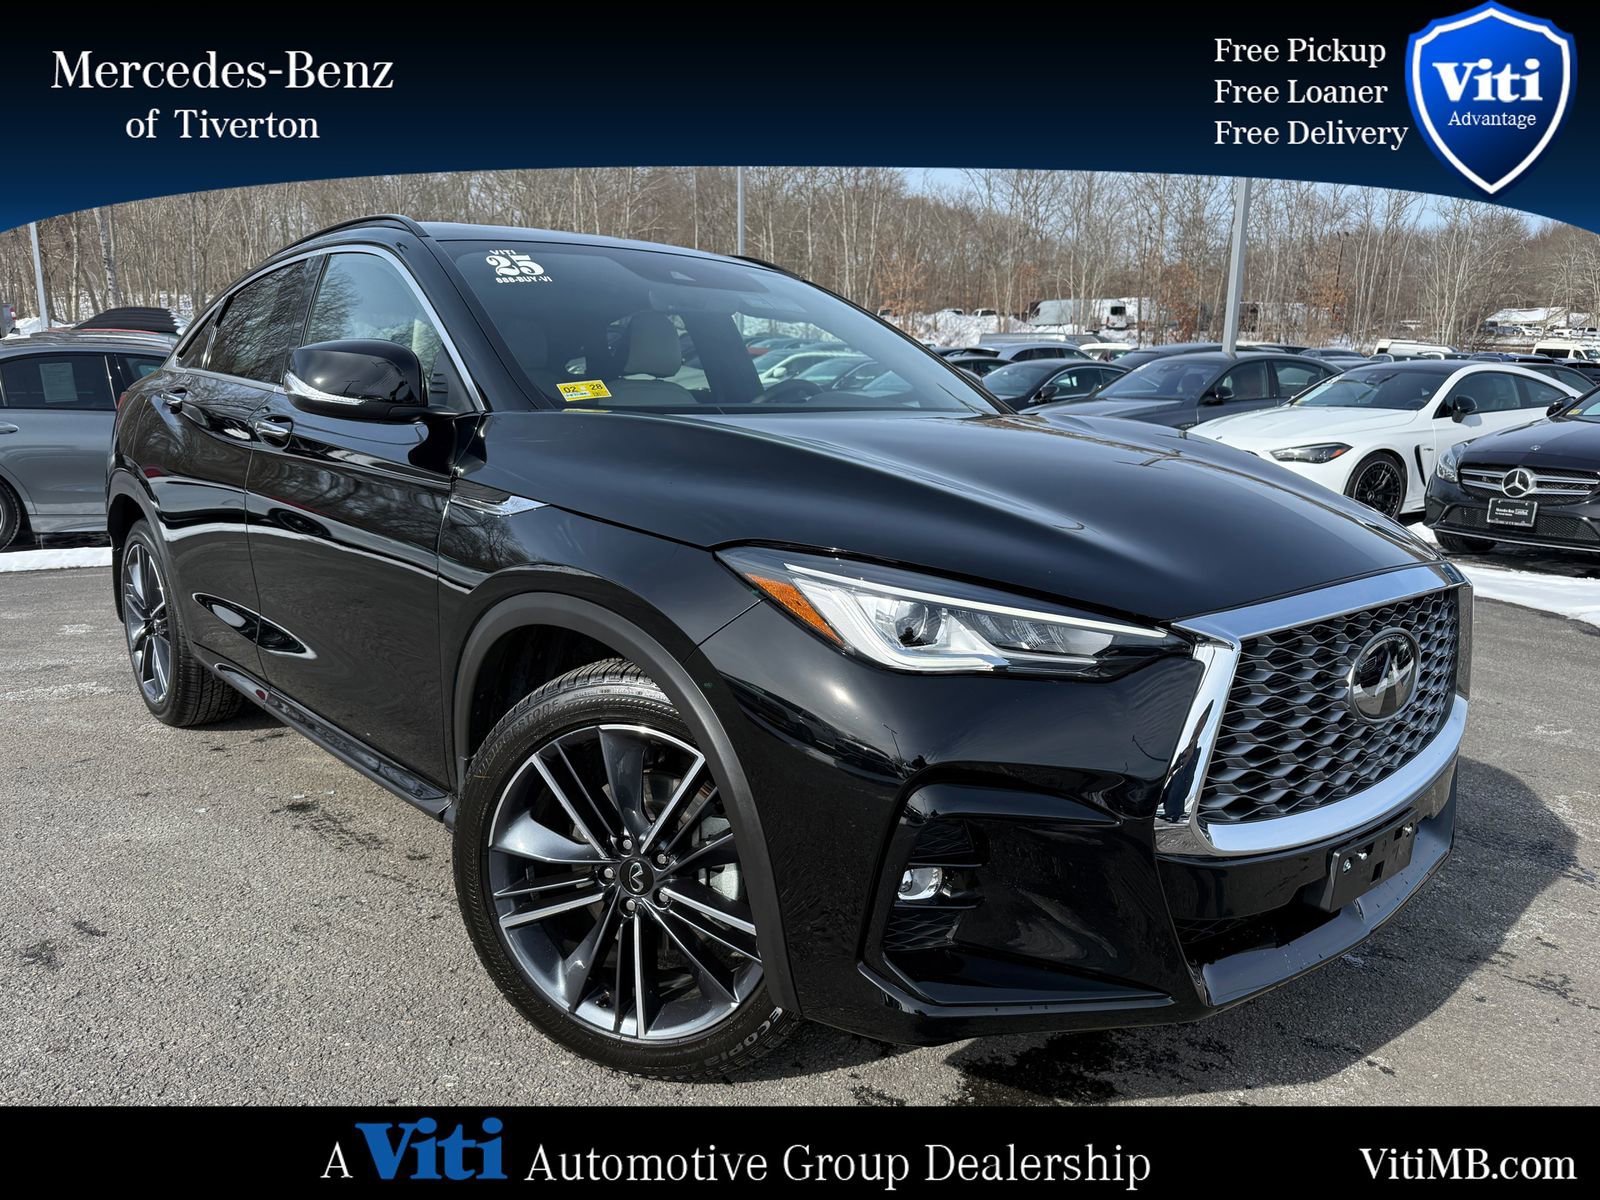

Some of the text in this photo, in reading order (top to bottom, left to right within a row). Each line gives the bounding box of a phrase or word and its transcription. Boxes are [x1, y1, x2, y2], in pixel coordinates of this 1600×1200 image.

[485, 254, 545, 276] 25
[563, 383, 603, 394] 02 28
